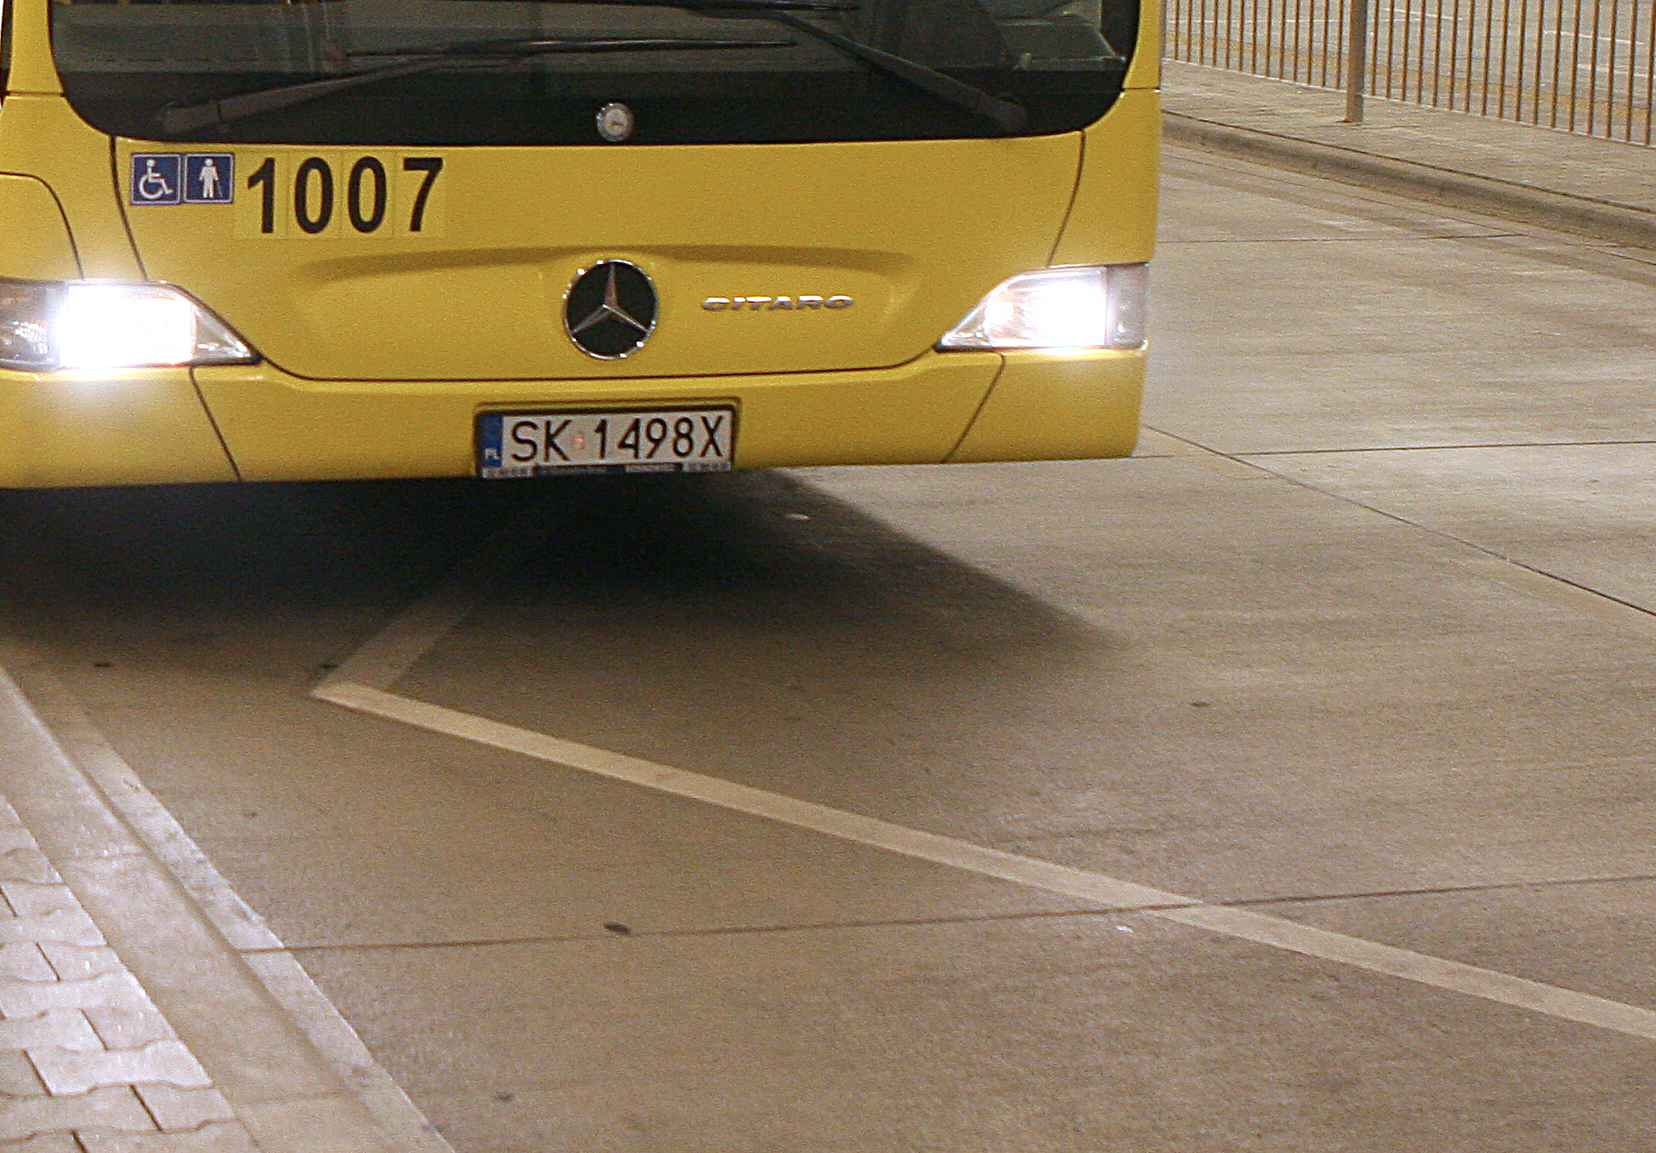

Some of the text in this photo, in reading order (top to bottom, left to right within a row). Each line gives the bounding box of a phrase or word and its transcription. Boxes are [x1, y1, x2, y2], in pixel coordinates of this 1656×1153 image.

[247, 156, 444, 234] 1007
[702, 295, 854, 311] CITARO
[485, 415, 724, 462] PL SK 1498X
